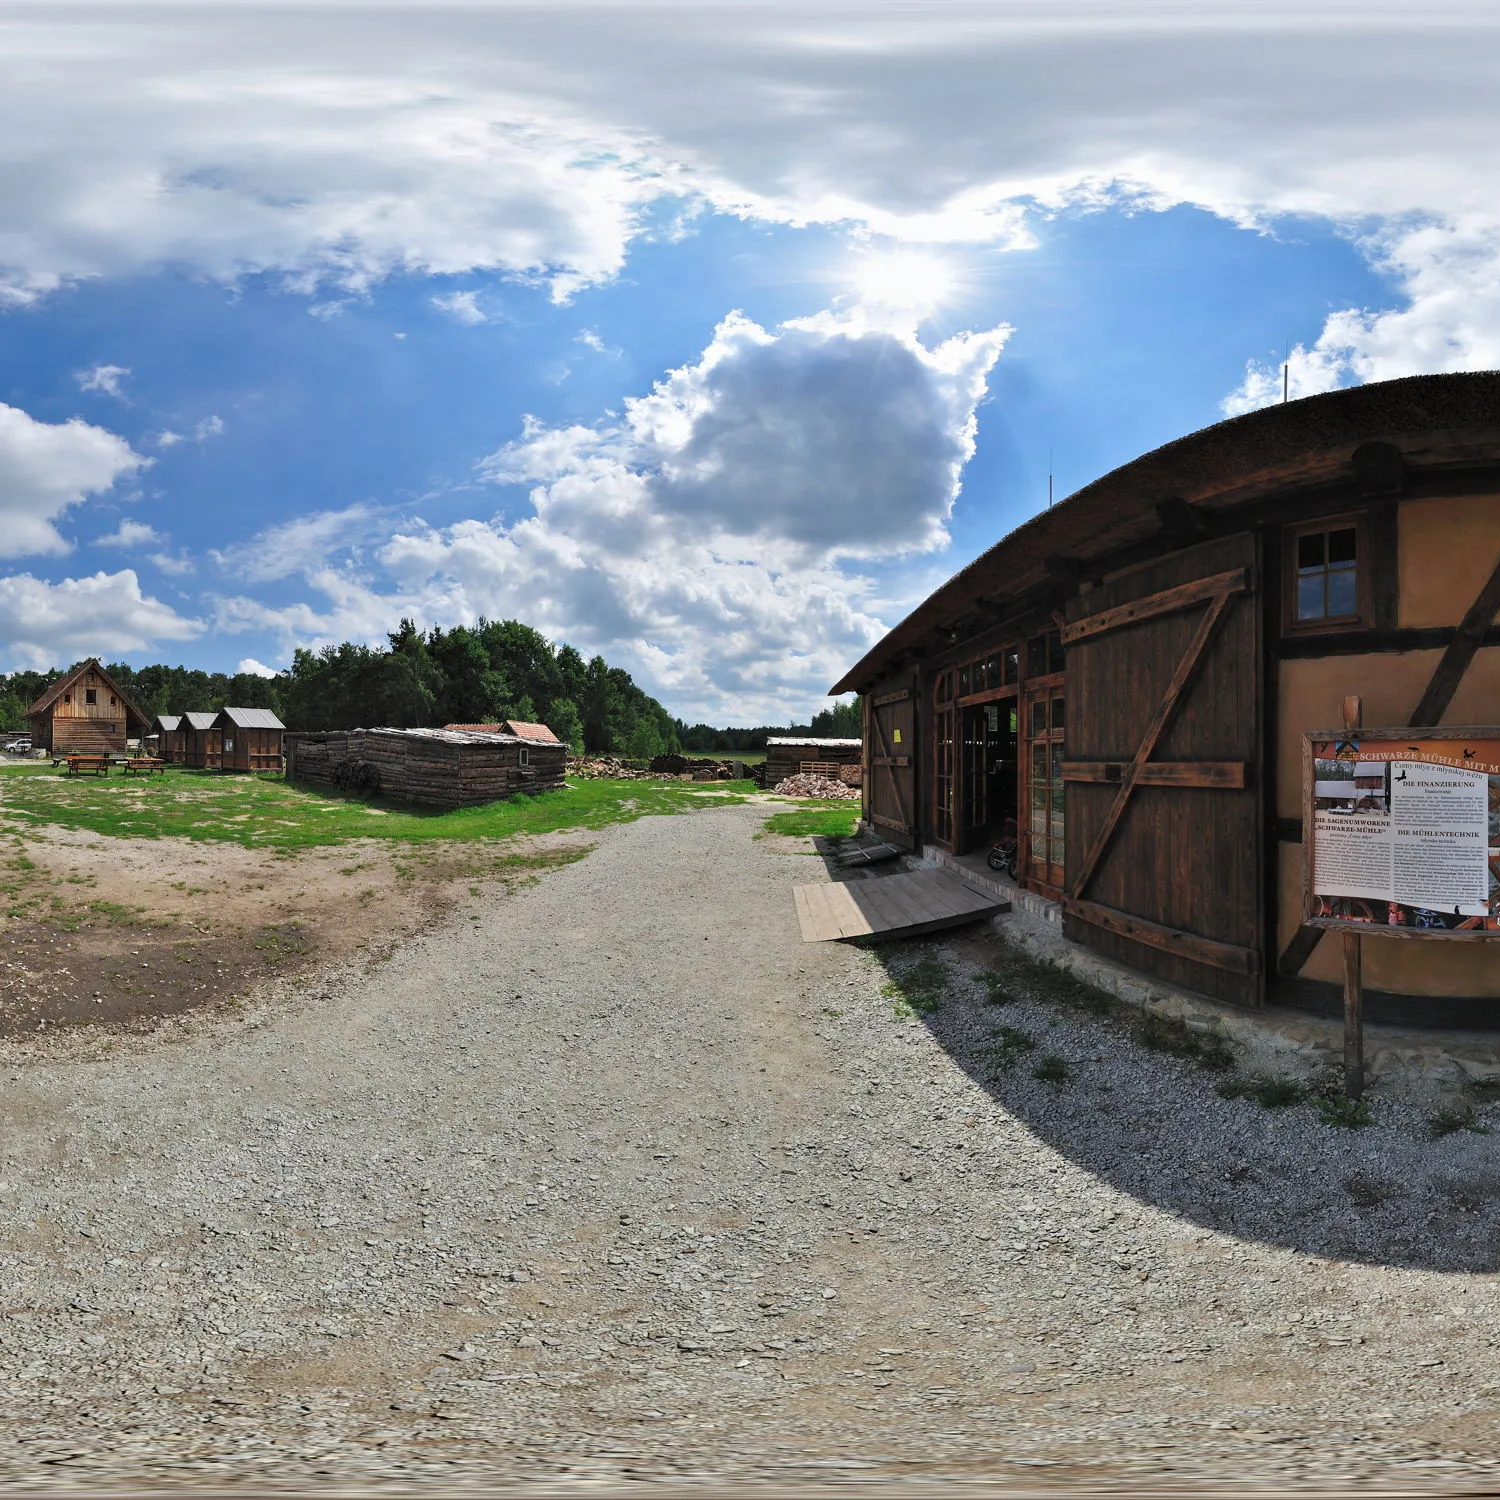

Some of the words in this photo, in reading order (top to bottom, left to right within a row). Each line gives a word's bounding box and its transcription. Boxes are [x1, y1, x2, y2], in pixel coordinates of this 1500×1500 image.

[1360, 751, 1417, 760] SCHWARZE
[1420, 752, 1462, 766] MÜHLE
[1464, 760, 1486, 770] MIT
[1327, 818, 1391, 826] SAGENUMWOBENE
[1412, 829, 1480, 838] MÜHLENTECHNIK
